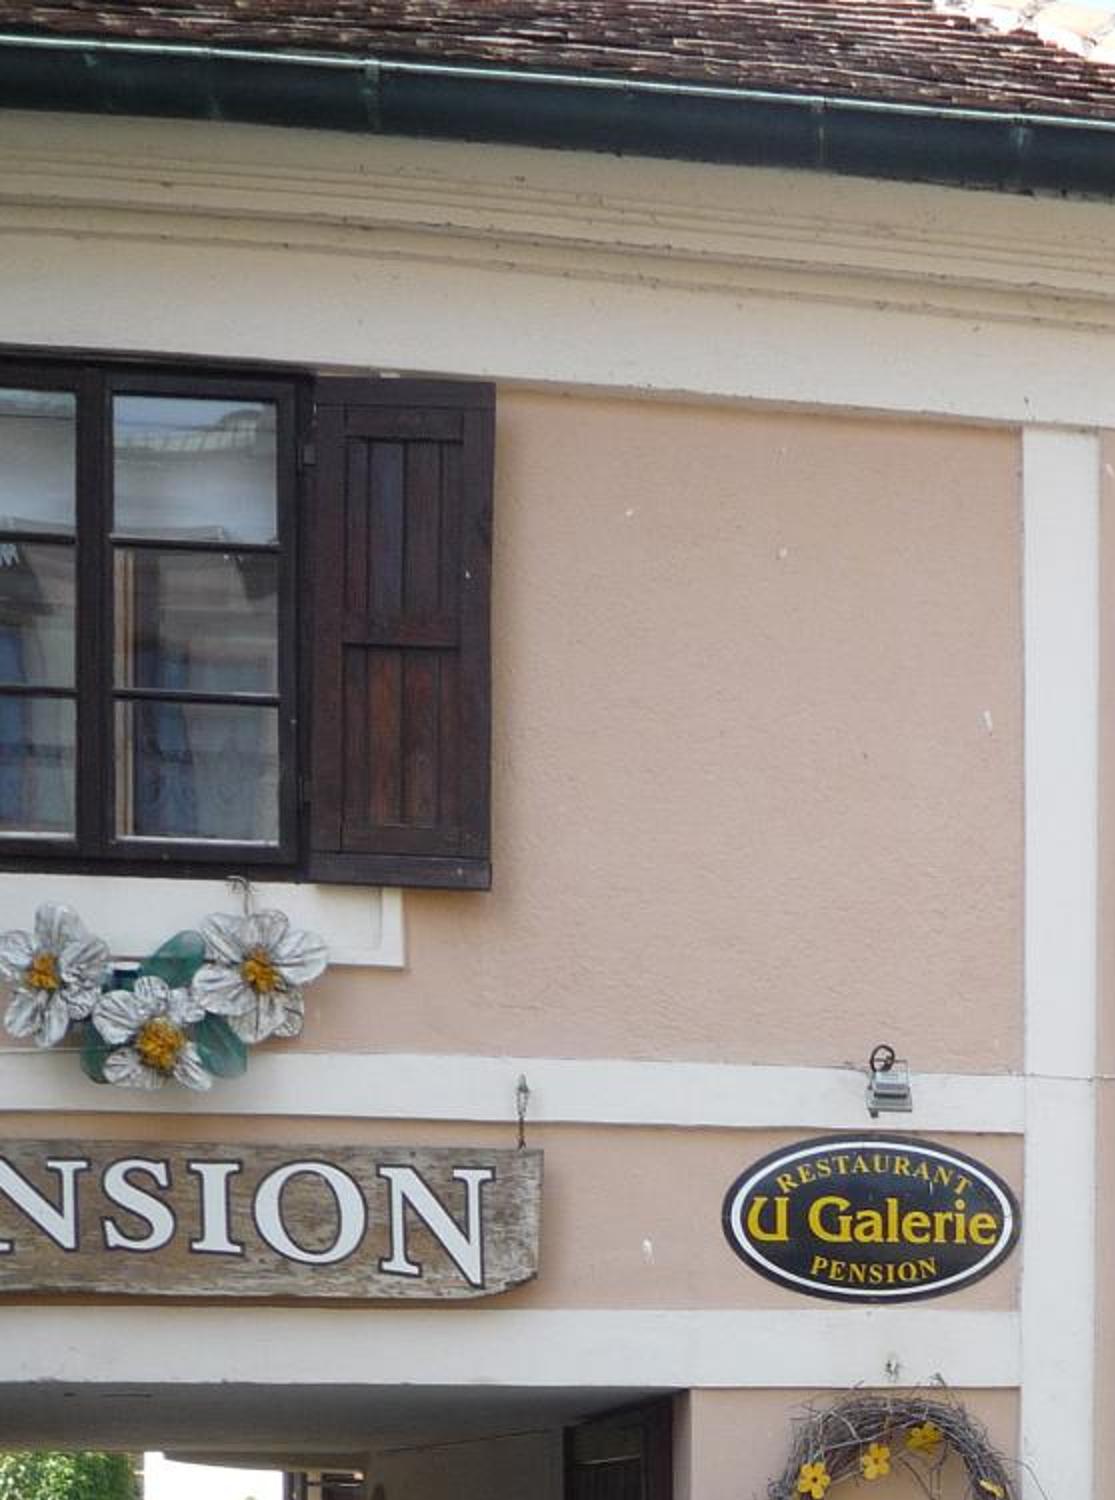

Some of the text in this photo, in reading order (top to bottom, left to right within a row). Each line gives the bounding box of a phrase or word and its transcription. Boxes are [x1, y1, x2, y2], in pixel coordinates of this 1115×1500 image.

[775, 1153, 974, 1196] RESTAURANT
[808, 1195, 998, 1245] Galerie
[810, 1255, 938, 1284] PENSION
